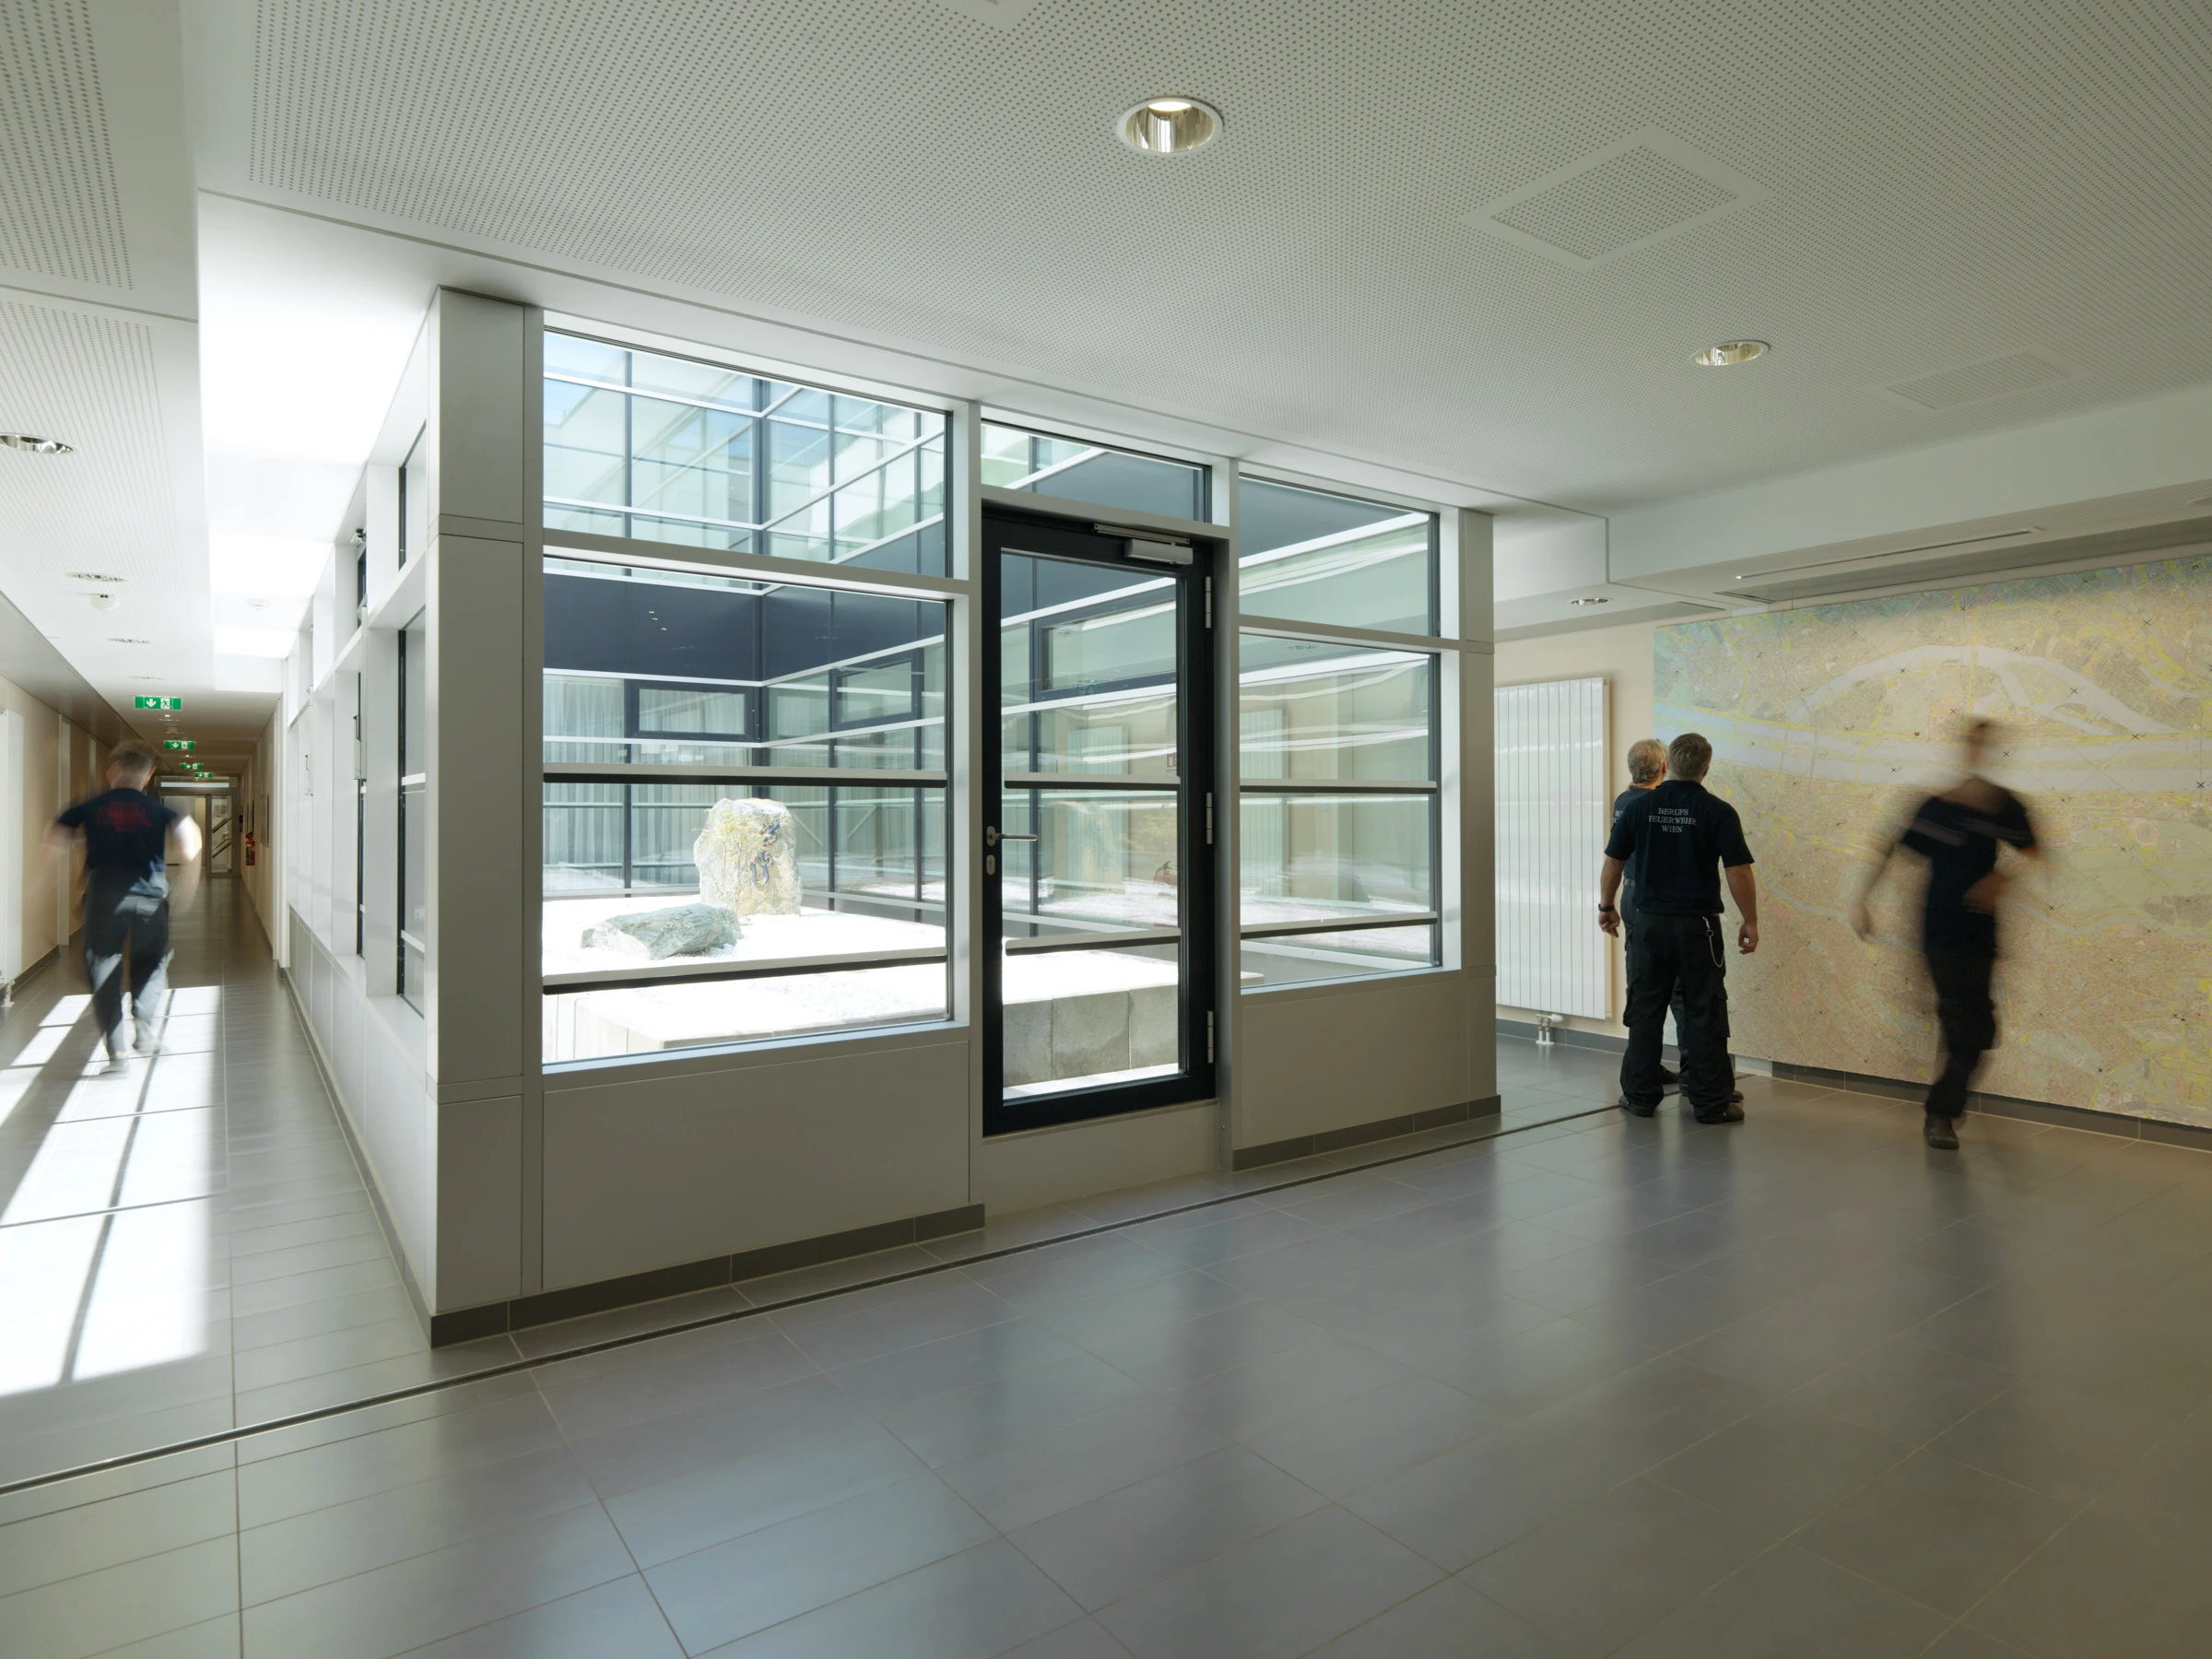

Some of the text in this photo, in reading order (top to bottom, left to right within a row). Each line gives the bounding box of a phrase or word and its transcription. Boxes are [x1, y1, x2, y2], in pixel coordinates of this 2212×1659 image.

[1658, 807, 1688, 816] BERUFS
[1648, 815, 1696, 825] FEUERWEHR
[1662, 825, 1683, 833] WIEN
